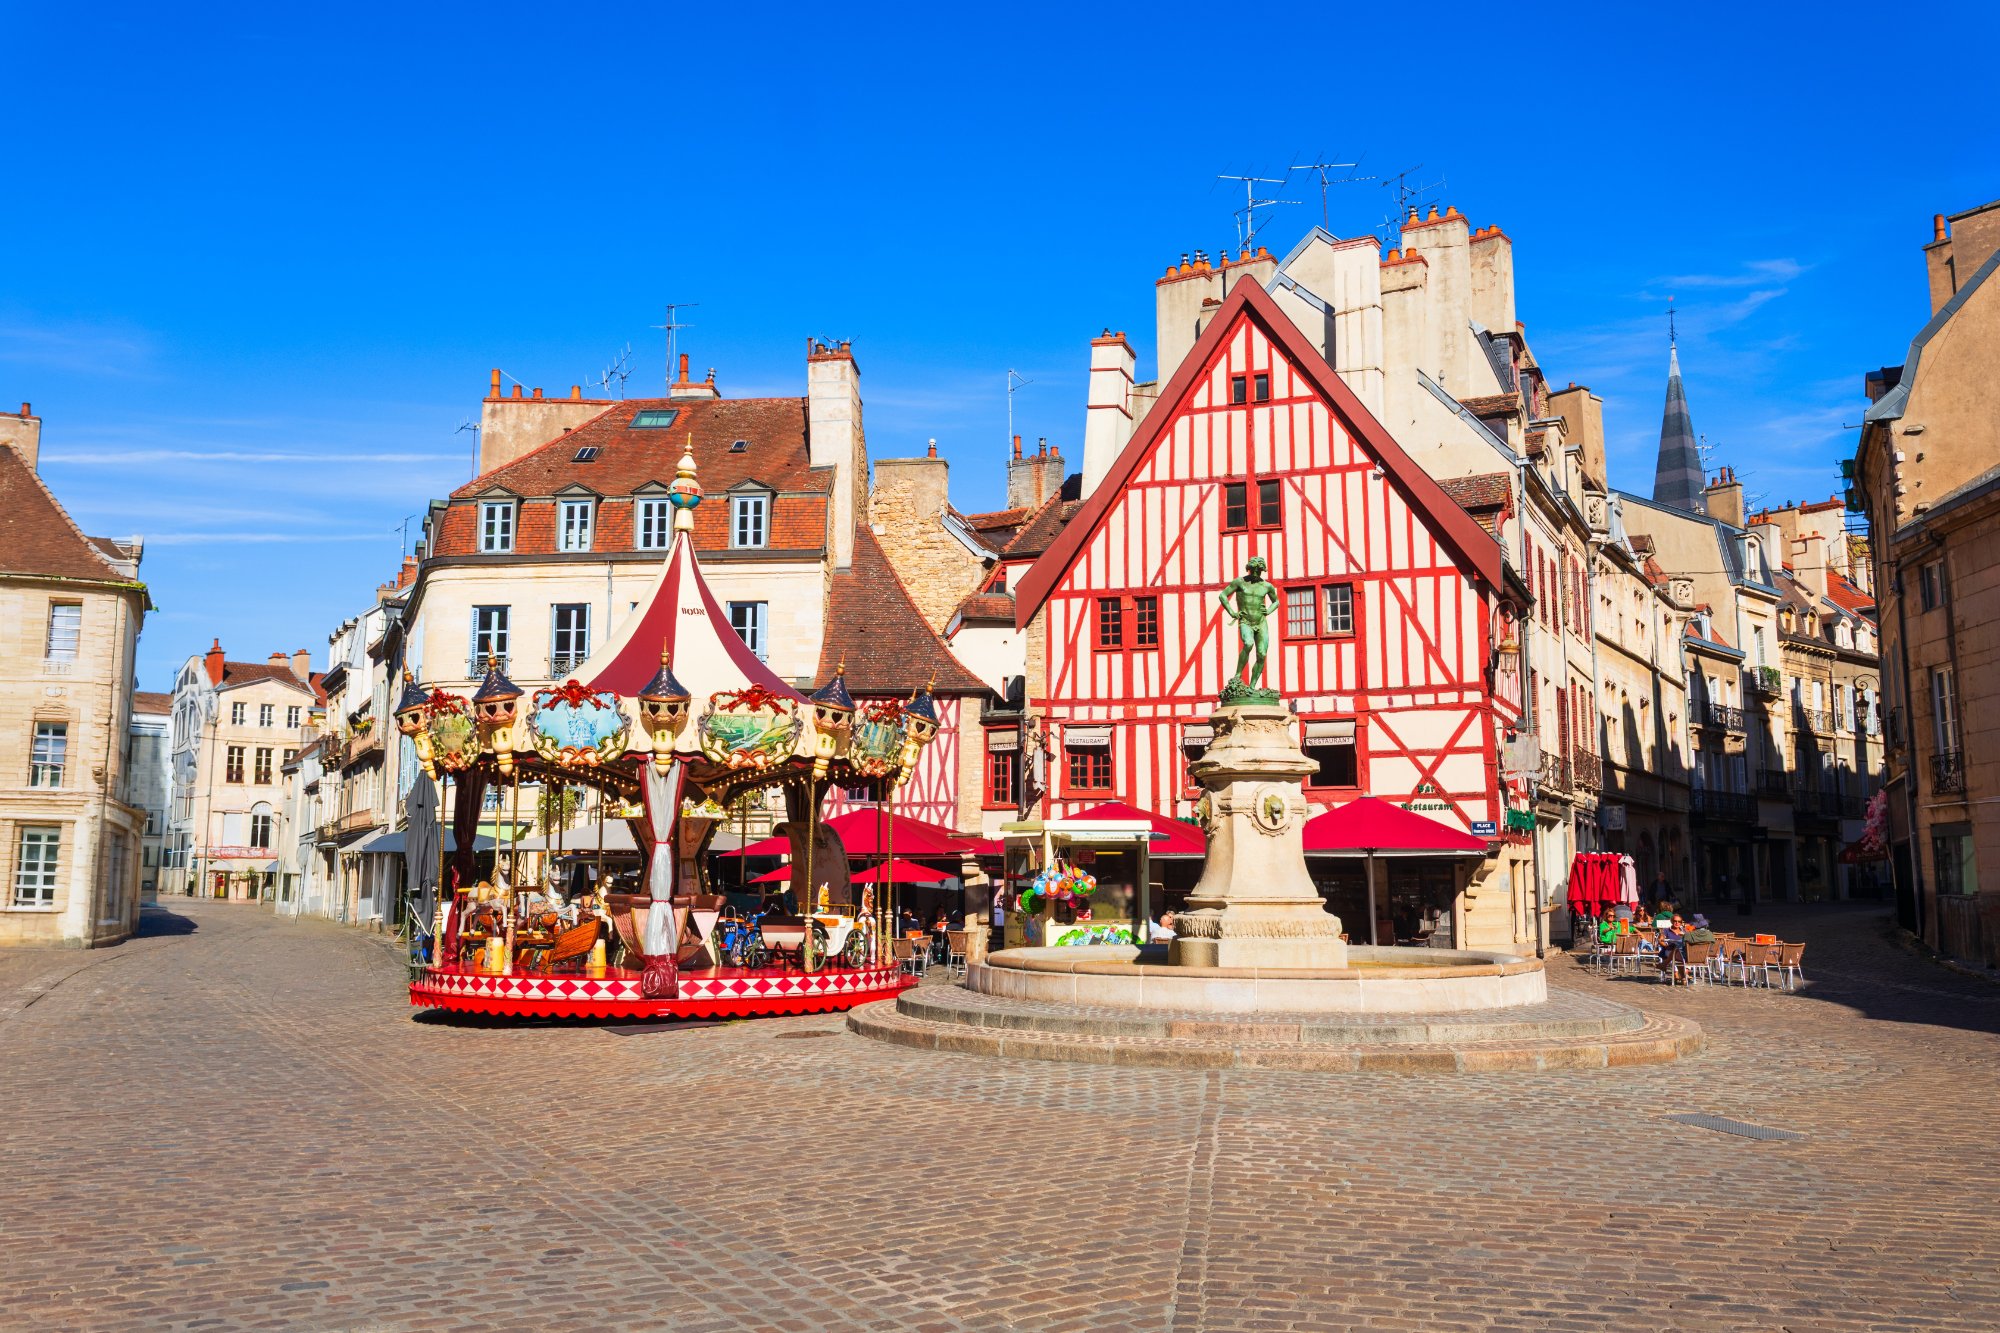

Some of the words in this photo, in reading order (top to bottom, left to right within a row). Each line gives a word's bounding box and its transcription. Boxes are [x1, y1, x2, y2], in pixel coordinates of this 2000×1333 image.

[1307, 737, 1351, 745] RESTAURANT
[1417, 784, 1435, 794] Bar
[1401, 803, 1454, 811] Restaurant
